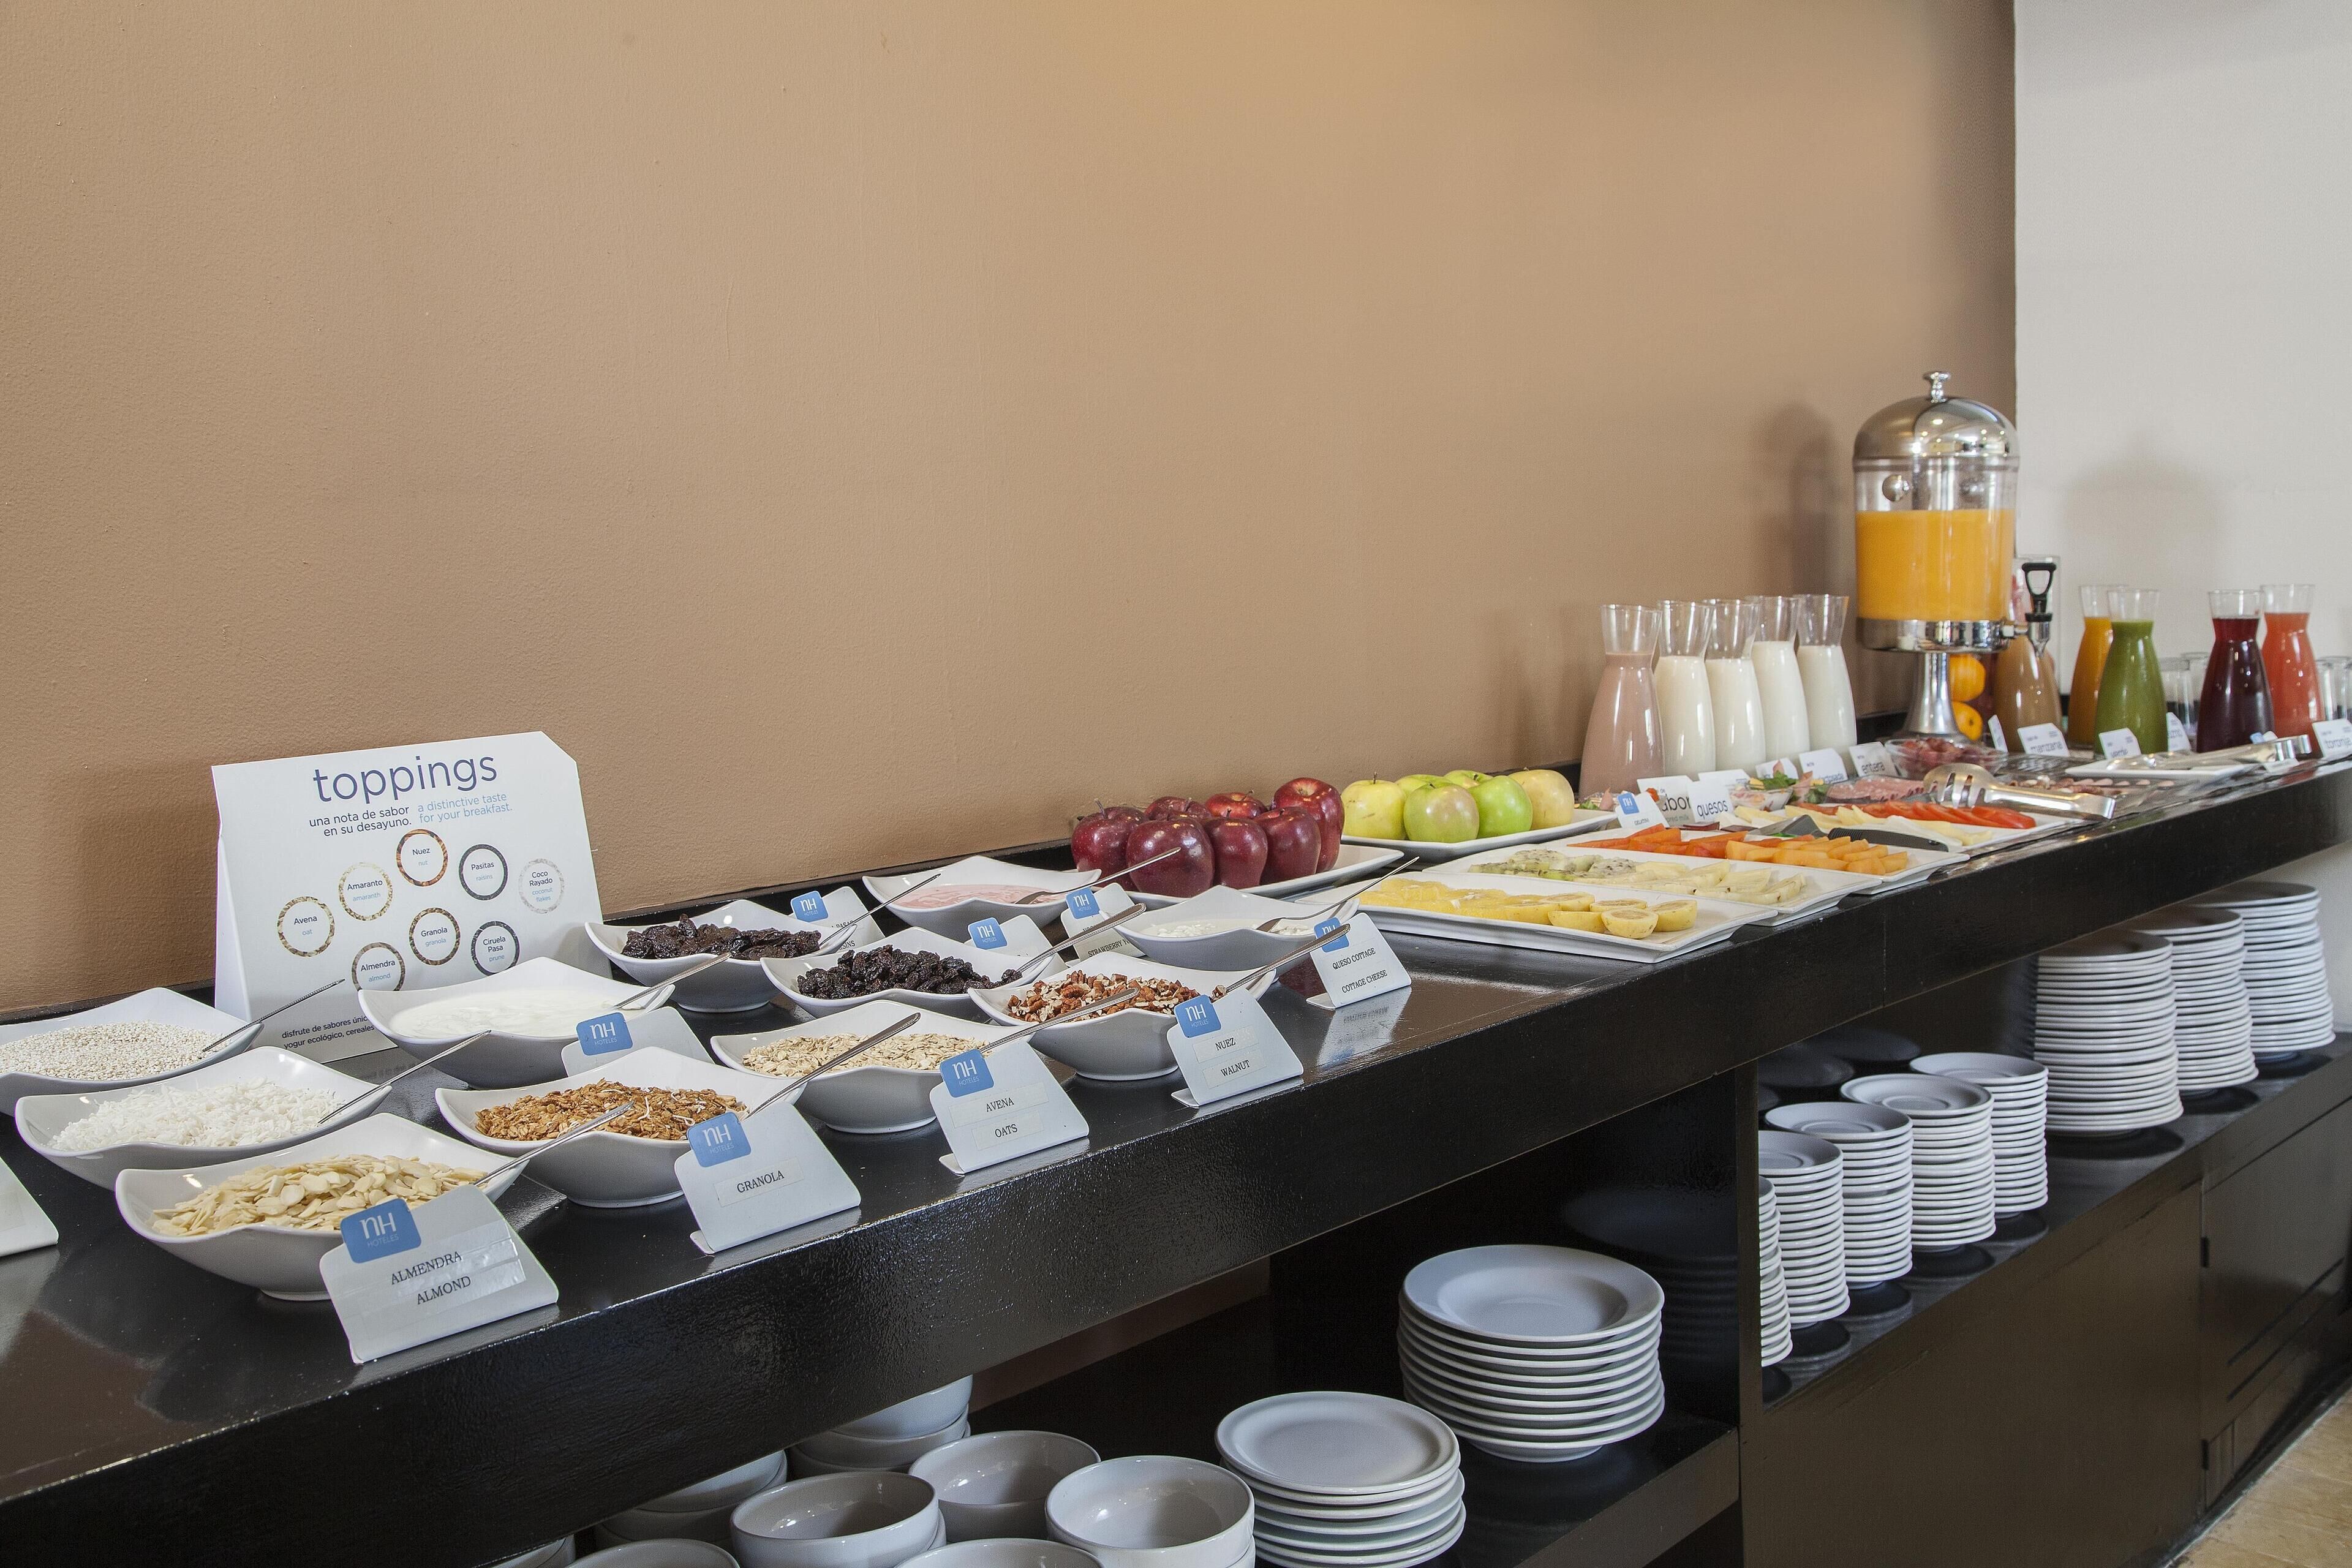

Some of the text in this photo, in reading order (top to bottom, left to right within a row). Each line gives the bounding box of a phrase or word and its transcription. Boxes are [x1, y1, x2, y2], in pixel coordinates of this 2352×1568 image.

[1862, 761, 1886, 774] entera
[313, 755, 498, 804] toppings
[418, 793, 507, 813] a distinctive taste
[309, 805, 410, 827] una nota de sabor
[420, 803, 513, 824] for your breakfast.
[1697, 800, 1728, 820] quesos
[323, 818, 412, 837] en su desayuno.
[471, 862, 495, 871] Pasitas
[476, 873, 493, 882] raisins
[532, 870, 548, 879] Coco
[347, 879, 383, 891] Amaranto
[529, 877, 553, 887] Rayado
[352, 891, 381, 902] amaranth
[532, 887, 553, 895] coconut
[293, 915, 318, 925] Avena
[421, 926, 448, 937] Granola
[425, 937, 447, 947] granola
[483, 936, 507, 946] Ciruela
[488, 944, 503, 953] Pasa
[1088, 939, 1123, 957] STRAWBERRY
[360, 959, 396, 972] Almendra
[1332, 948, 1376, 970] QUESO COTTAGE
[369, 973, 391, 982] almond
[1341, 970, 1388, 993] COTTAGE CHEESE
[282, 1027, 311, 1039] disfrute
[323, 1019, 351, 1030] sabores
[352, 1015, 368, 1024] únic
[1191, 1019, 1209, 1028] HOTELES
[284, 1024, 375, 1050] yogur ecológico, cereales
[594, 1037, 617, 1046] HOTELES
[1215, 1038, 1236, 1051] NUEZ
[1220, 1060, 1250, 1077] WALNUT
[958, 1076, 980, 1087] HOTELES
[986, 1097, 1014, 1112] AVENA
[995, 1123, 1018, 1138] OATS
[710, 1142, 735, 1155] HOTELES
[737, 1170, 785, 1193] GRANOLA
[367, 1234, 400, 1248] HOTELES
[391, 1251, 462, 1285] ALMENDRA
[417, 1276, 472, 1305] ALMOND
